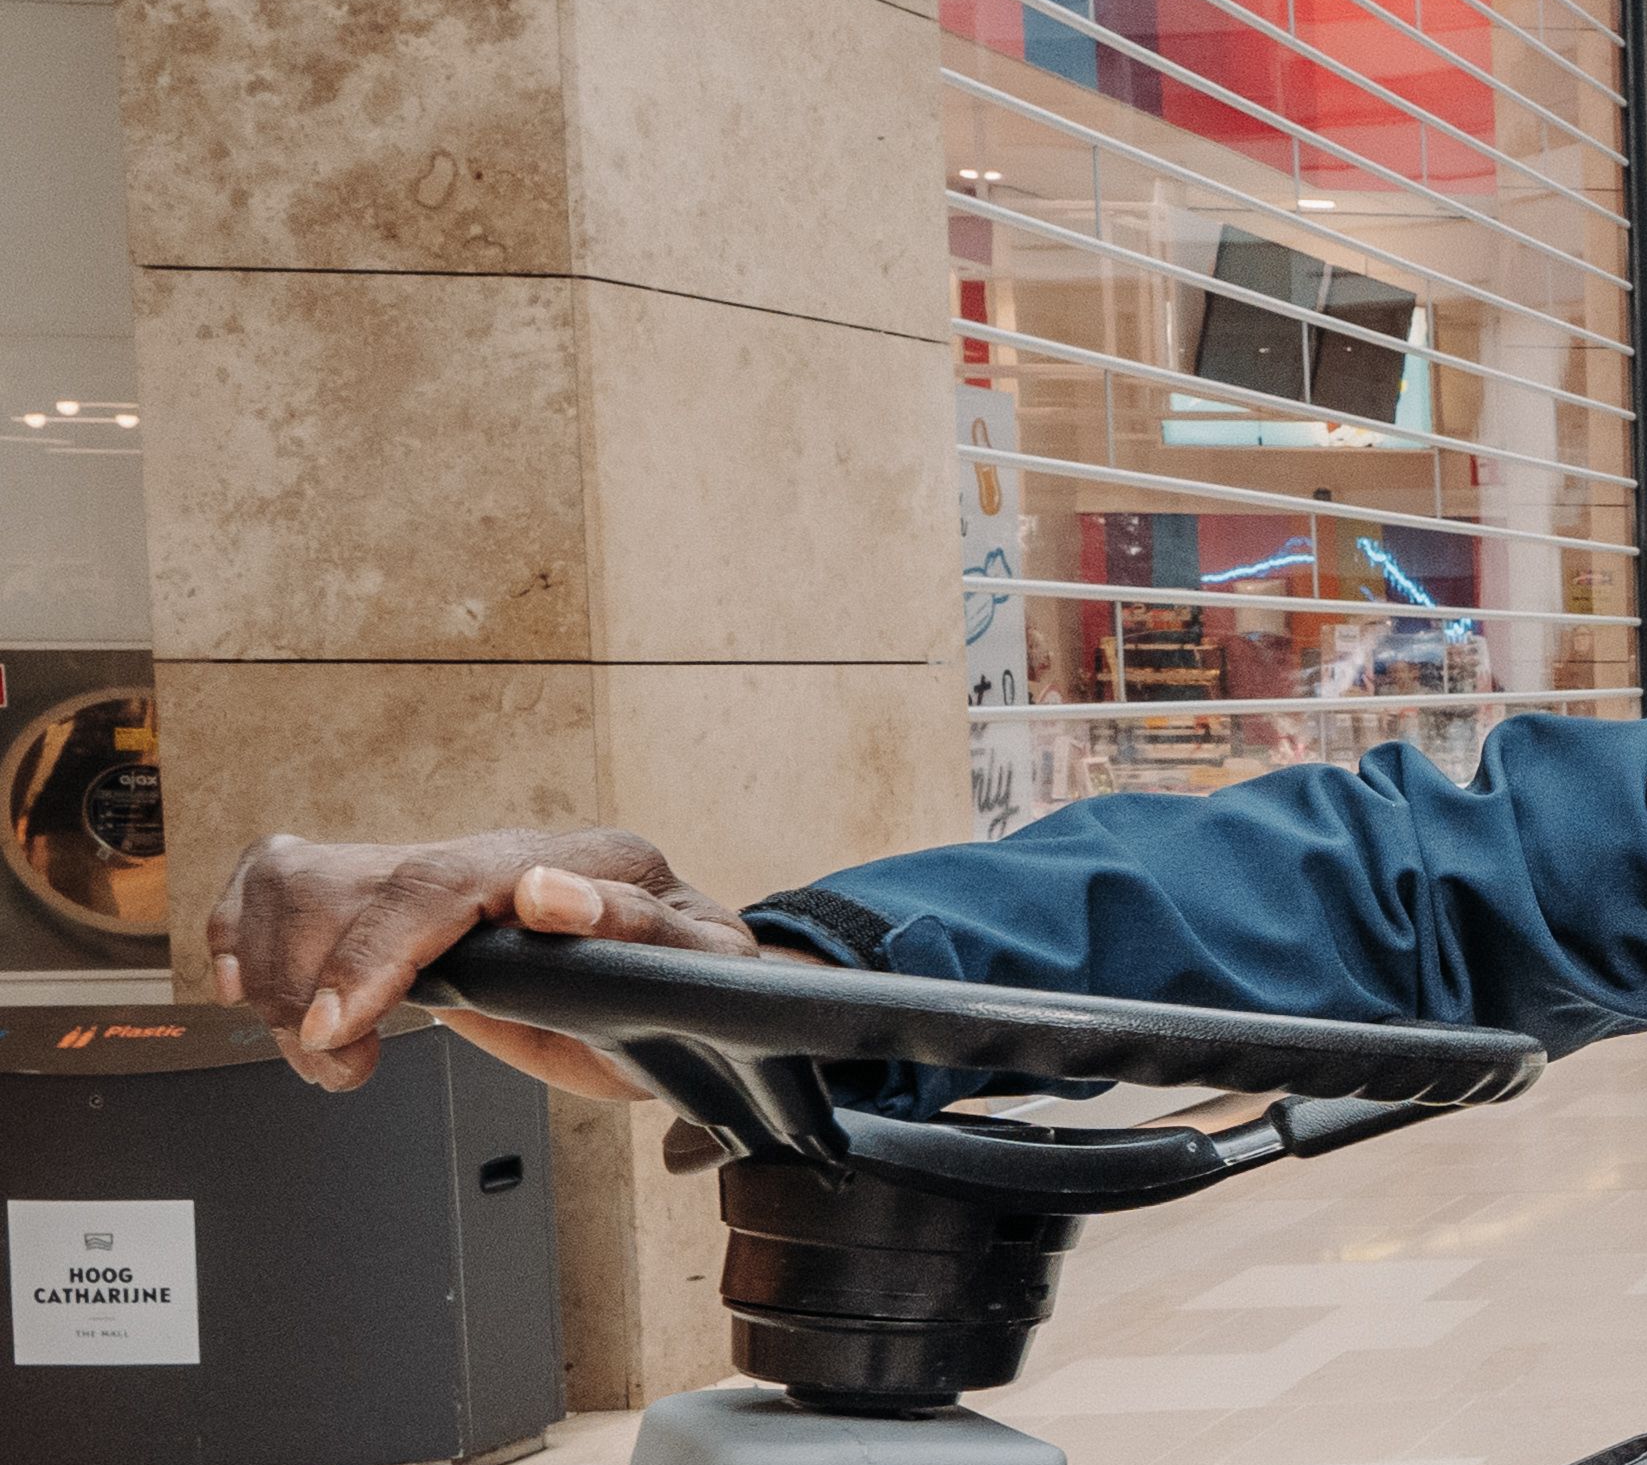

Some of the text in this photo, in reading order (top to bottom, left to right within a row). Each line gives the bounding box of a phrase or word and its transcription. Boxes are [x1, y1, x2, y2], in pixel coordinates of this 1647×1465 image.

[103, 1024, 186, 1038] Plastic
[70, 1267, 133, 1284] HOOG
[34, 1287, 171, 1304] CATHARIJNE
